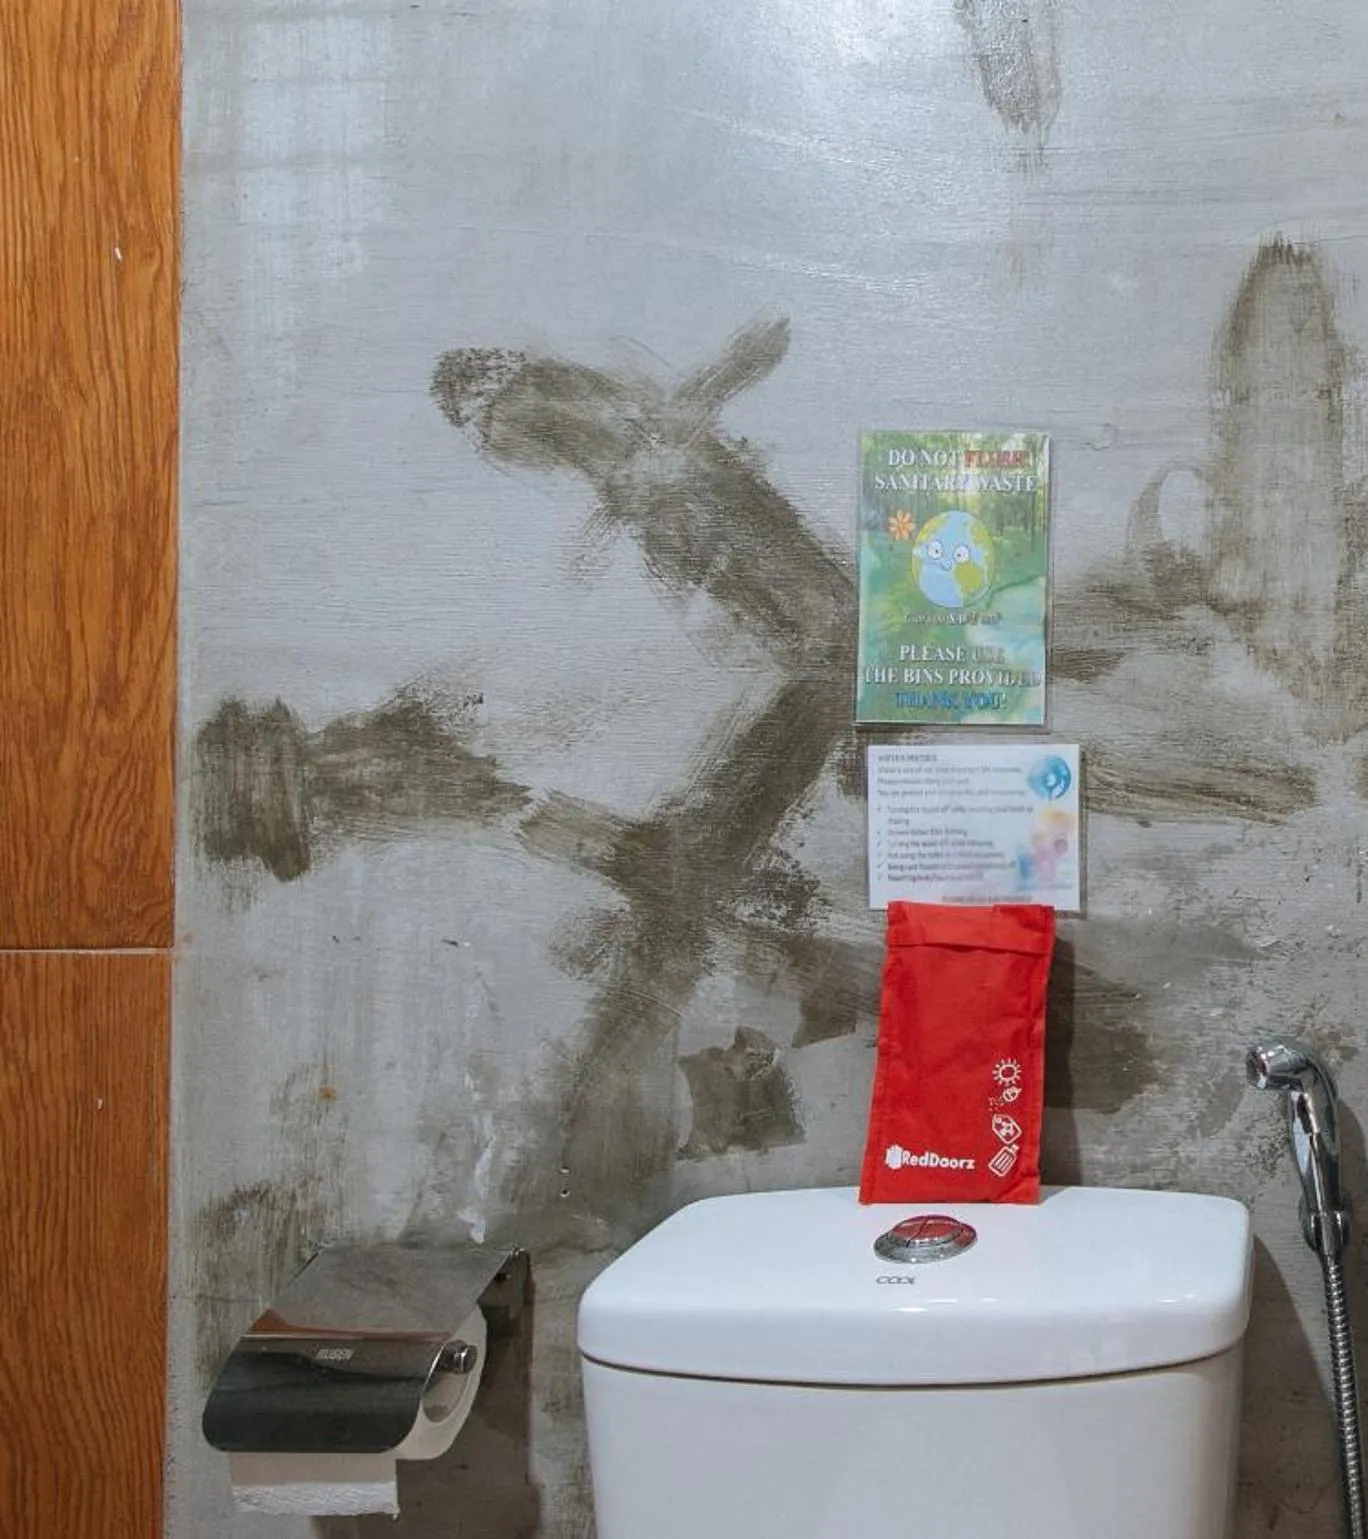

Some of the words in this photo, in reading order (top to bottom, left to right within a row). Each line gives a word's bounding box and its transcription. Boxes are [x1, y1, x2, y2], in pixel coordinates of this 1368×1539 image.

[888, 448, 916, 467] DO
[919, 448, 959, 467] NOT
[975, 474, 1037, 492] WASTE
[900, 644, 966, 664] PLEASE
[864, 667, 899, 684] THE
[903, 667, 944, 686] BINS
[902, 1151, 976, 1170] RedDoorz
